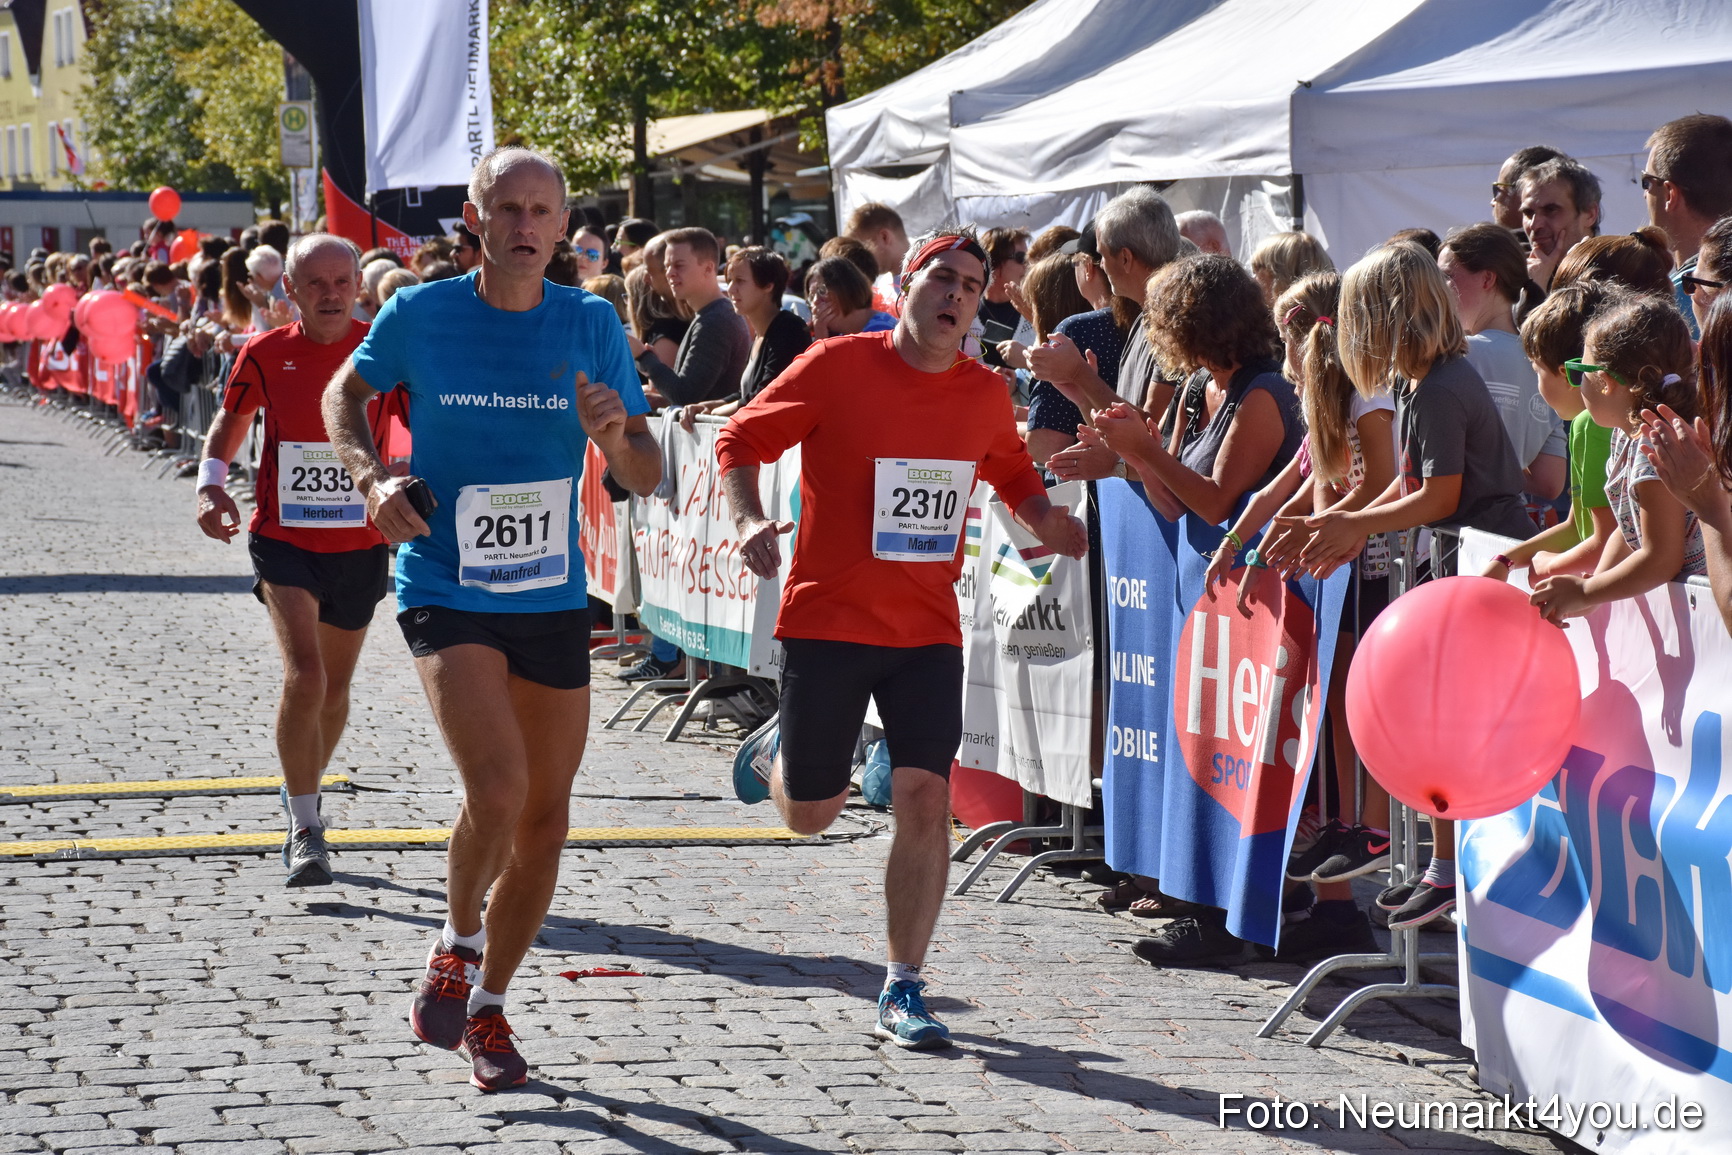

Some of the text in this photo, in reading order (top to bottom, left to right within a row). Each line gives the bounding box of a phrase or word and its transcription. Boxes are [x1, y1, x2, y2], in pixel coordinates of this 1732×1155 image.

[385, 237, 406, 248] THE
[439, 392, 569, 410] www.hasit.de
[291, 467, 354, 492] 2335
[908, 468, 952, 481] BOCK
[490, 491, 542, 506] BOCK
[892, 487, 957, 520] 2310
[303, 507, 343, 519] Herbert
[474, 510, 551, 549] 2611
[908, 537, 938, 551] Martin
[484, 549, 540, 561] PARTL Neumarkt
[489, 562, 541, 581] Manfred
[1024, 642, 1066, 659] genießen
[1113, 651, 1156, 687] NLINE
[1113, 725, 1158, 763] OBILE
